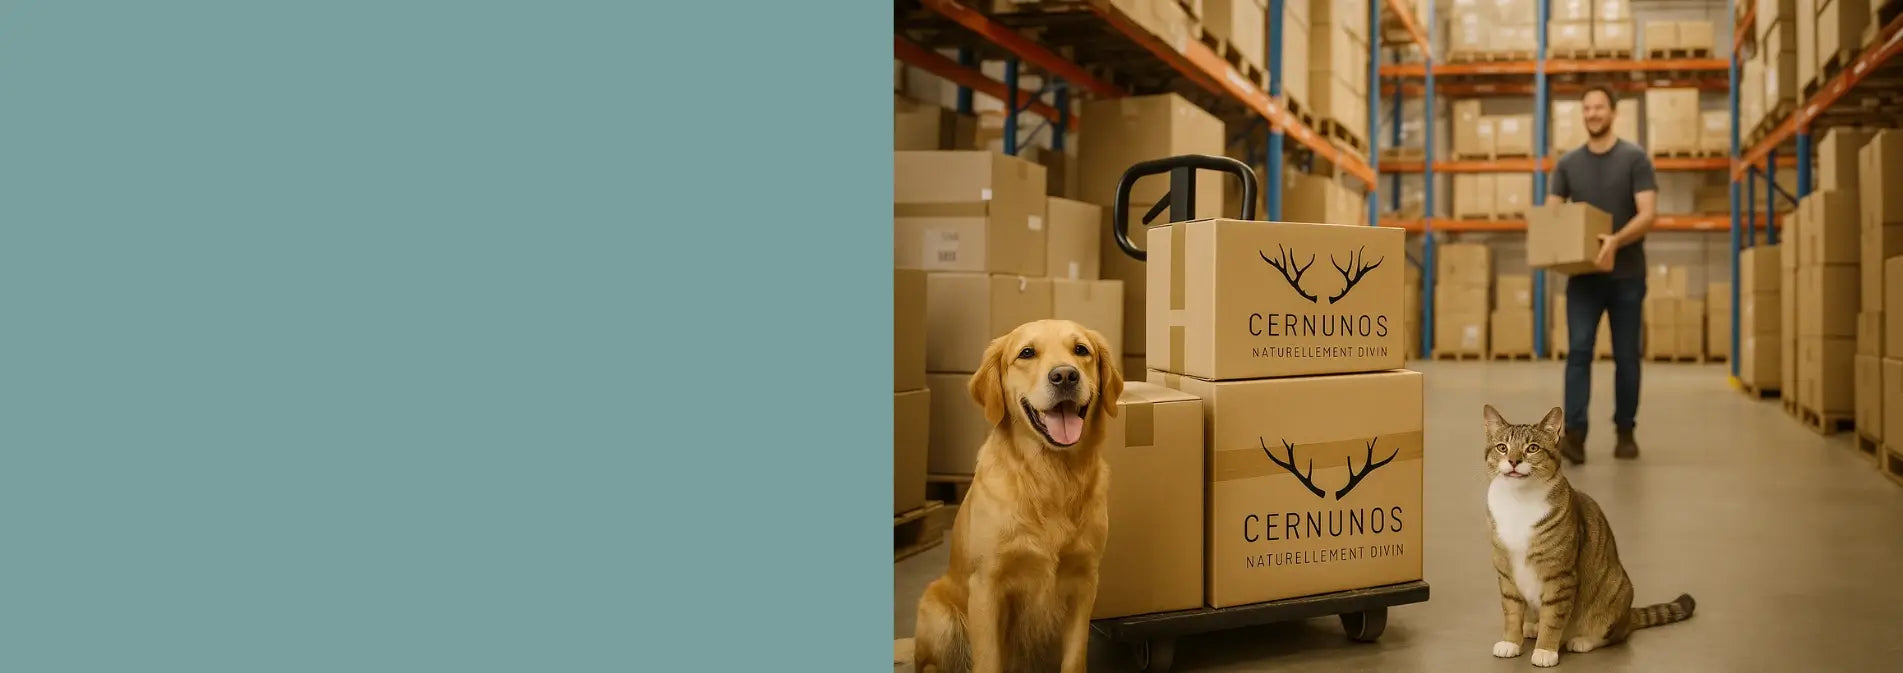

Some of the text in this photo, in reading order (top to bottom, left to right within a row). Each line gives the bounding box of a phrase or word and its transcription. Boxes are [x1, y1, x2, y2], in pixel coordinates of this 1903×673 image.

[1249, 313, 1388, 338] CERNUNOS
[1252, 346, 1388, 358] NATURELLEMENT DIVIN
[1244, 506, 1403, 543] CERNUNOS
[1246, 543, 1404, 569] NATURELLEMENT DIVIN
